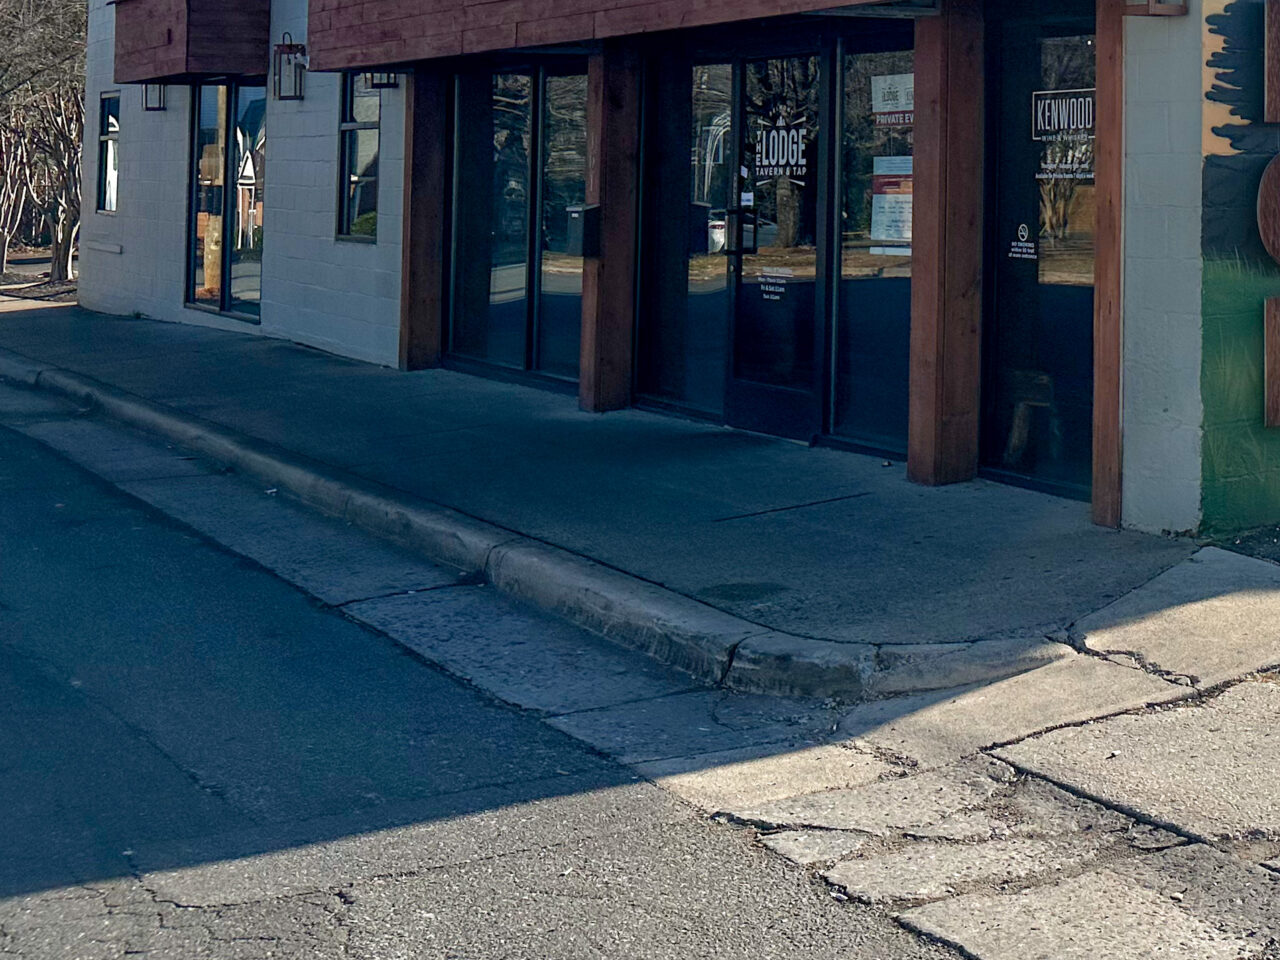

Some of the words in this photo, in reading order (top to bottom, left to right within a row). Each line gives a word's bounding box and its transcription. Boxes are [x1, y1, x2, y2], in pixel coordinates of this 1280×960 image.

[876, 113, 904, 125] PRIVATE
[1037, 97, 1093, 130] KENWOOD
[762, 128, 807, 166] LODGE
[755, 166, 784, 176] TAVERN
[793, 166, 807, 176] TAP
